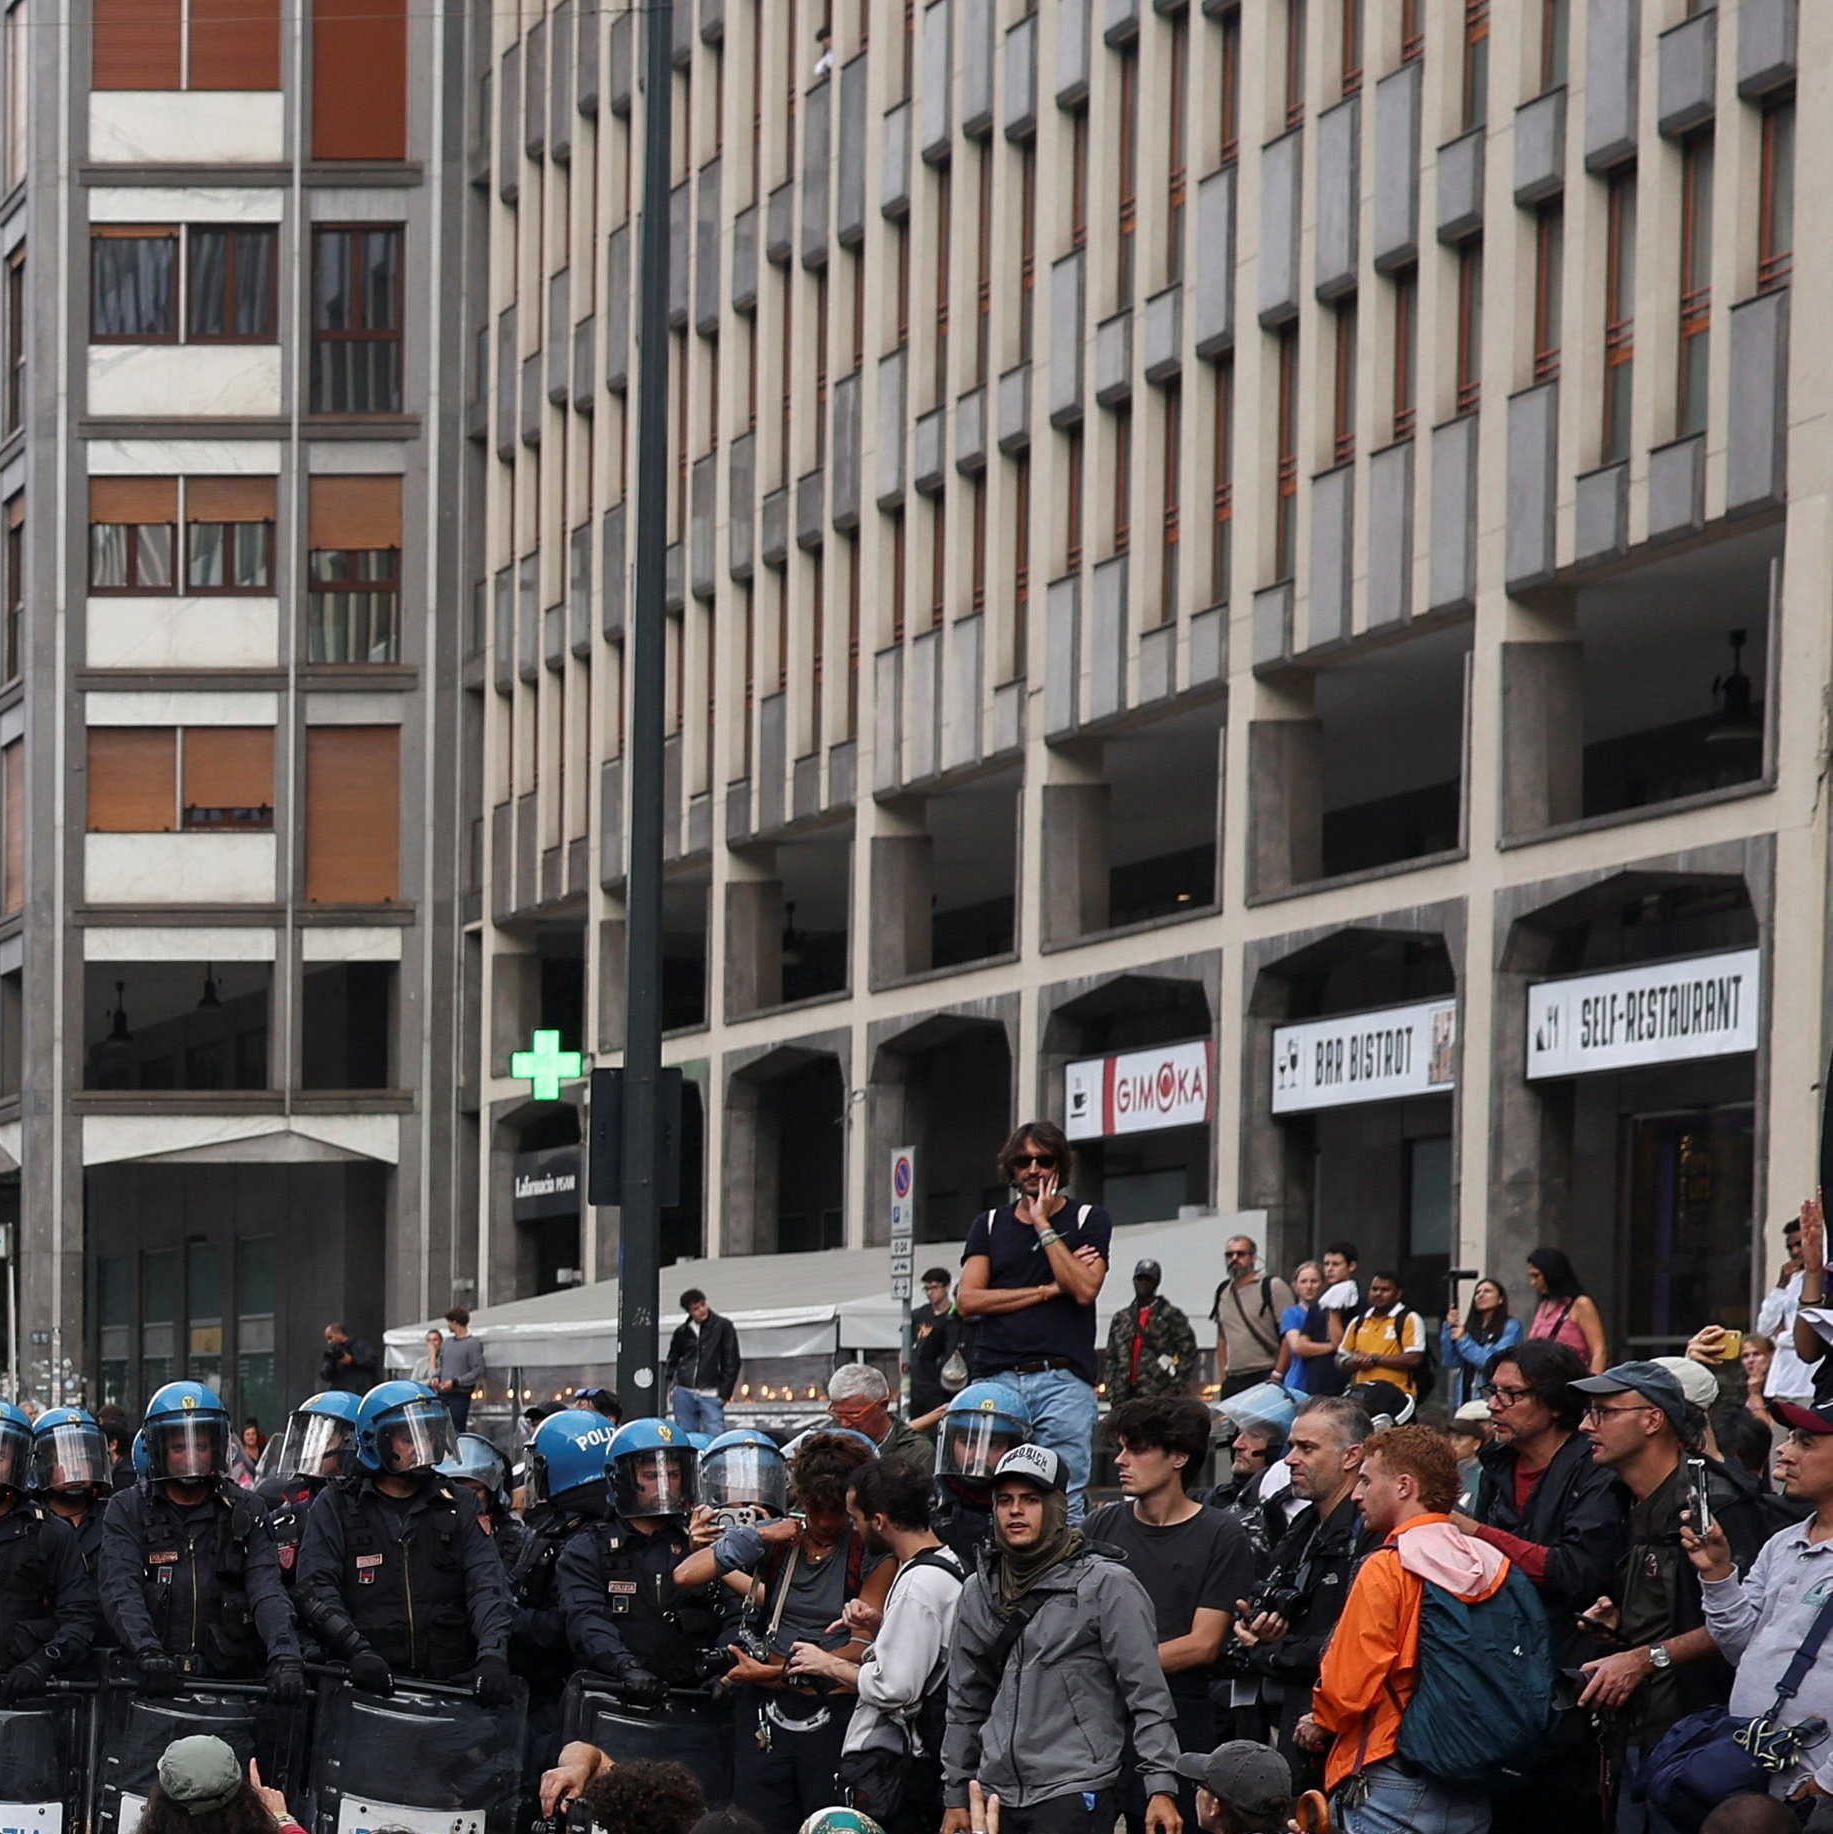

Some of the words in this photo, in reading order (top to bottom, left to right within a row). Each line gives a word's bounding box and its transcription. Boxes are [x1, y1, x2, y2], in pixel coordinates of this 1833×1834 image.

[1581, 975, 1742, 1049] SELF-RESTAURANT
[1316, 1038, 1343, 1086] BAR
[1350, 1027, 1413, 1081] BISTROT
[1118, 1061, 1204, 1113] GIMOKA
